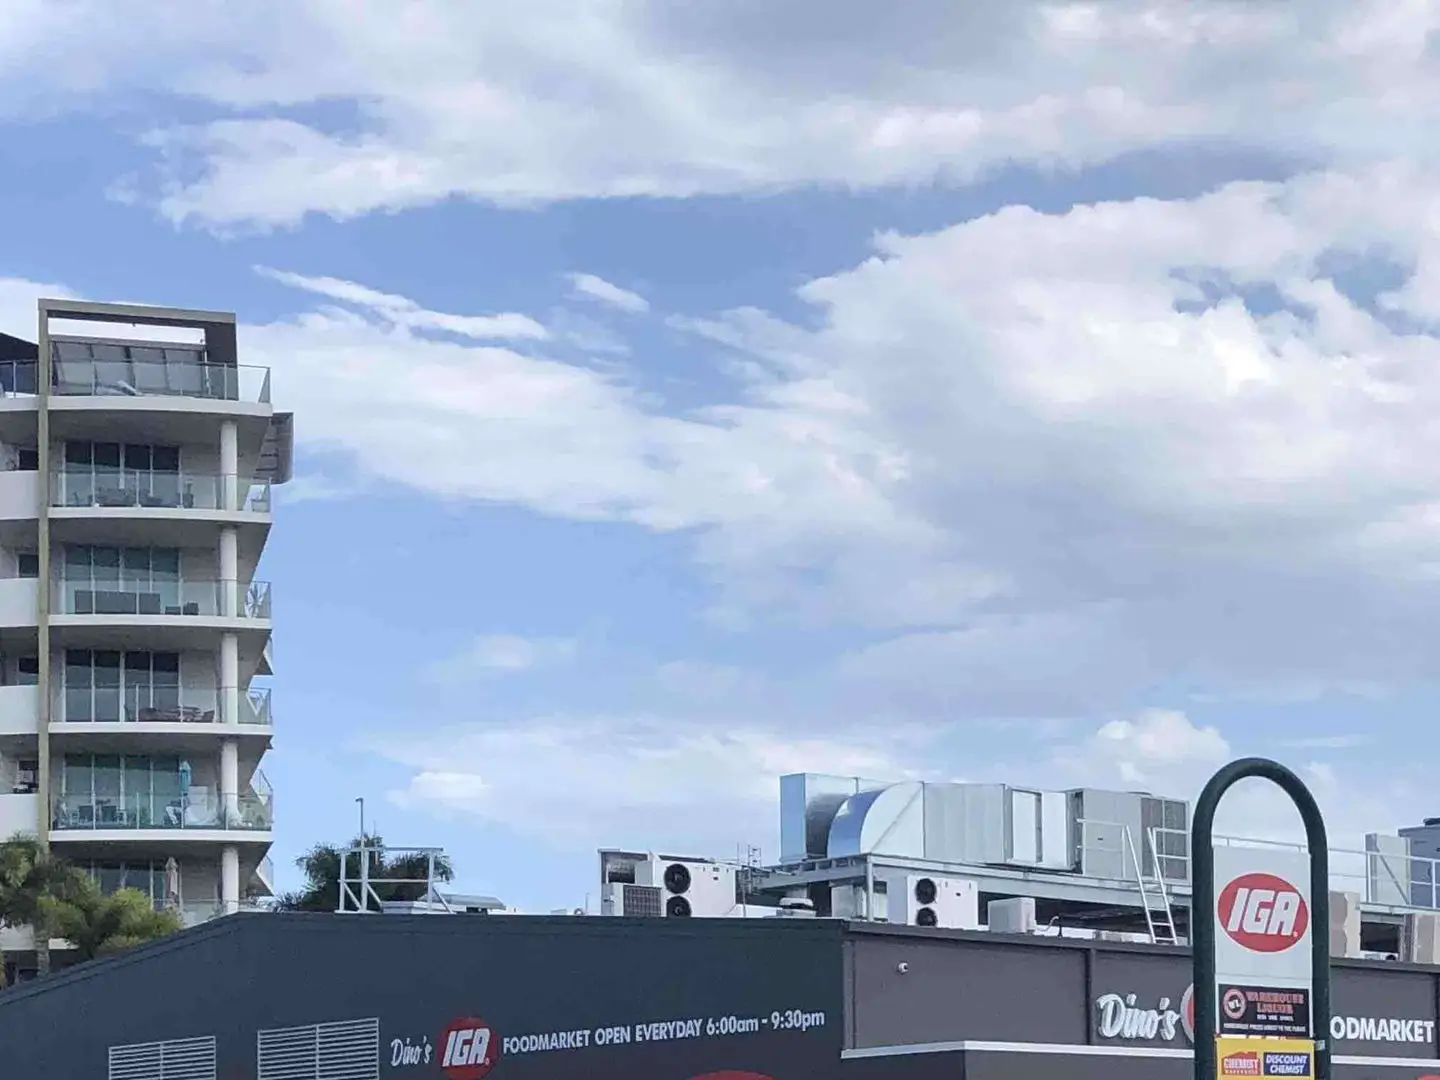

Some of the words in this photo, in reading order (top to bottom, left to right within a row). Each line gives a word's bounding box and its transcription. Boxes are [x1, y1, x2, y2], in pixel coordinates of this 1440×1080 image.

[1227, 887, 1301, 936] IGA
[1097, 993, 1180, 1041] Dino's
[1329, 1016, 1435, 1043] ODMARKET
[390, 1036, 432, 1067] Dino's
[442, 1027, 490, 1067] IGA
[503, 1030, 590, 1054] FOODMARKET
[594, 1026, 631, 1046] OPEN
[635, 1018, 702, 1042] EVERYDAY
[706, 1015, 759, 1036] 6:00am
[771, 1009, 825, 1032] 9:30pm
[1223, 1057, 1260, 1070] CHEMIST
[1266, 1054, 1308, 1065] DISCOUNT
[1269, 1064, 1305, 1075] CHEMIST
